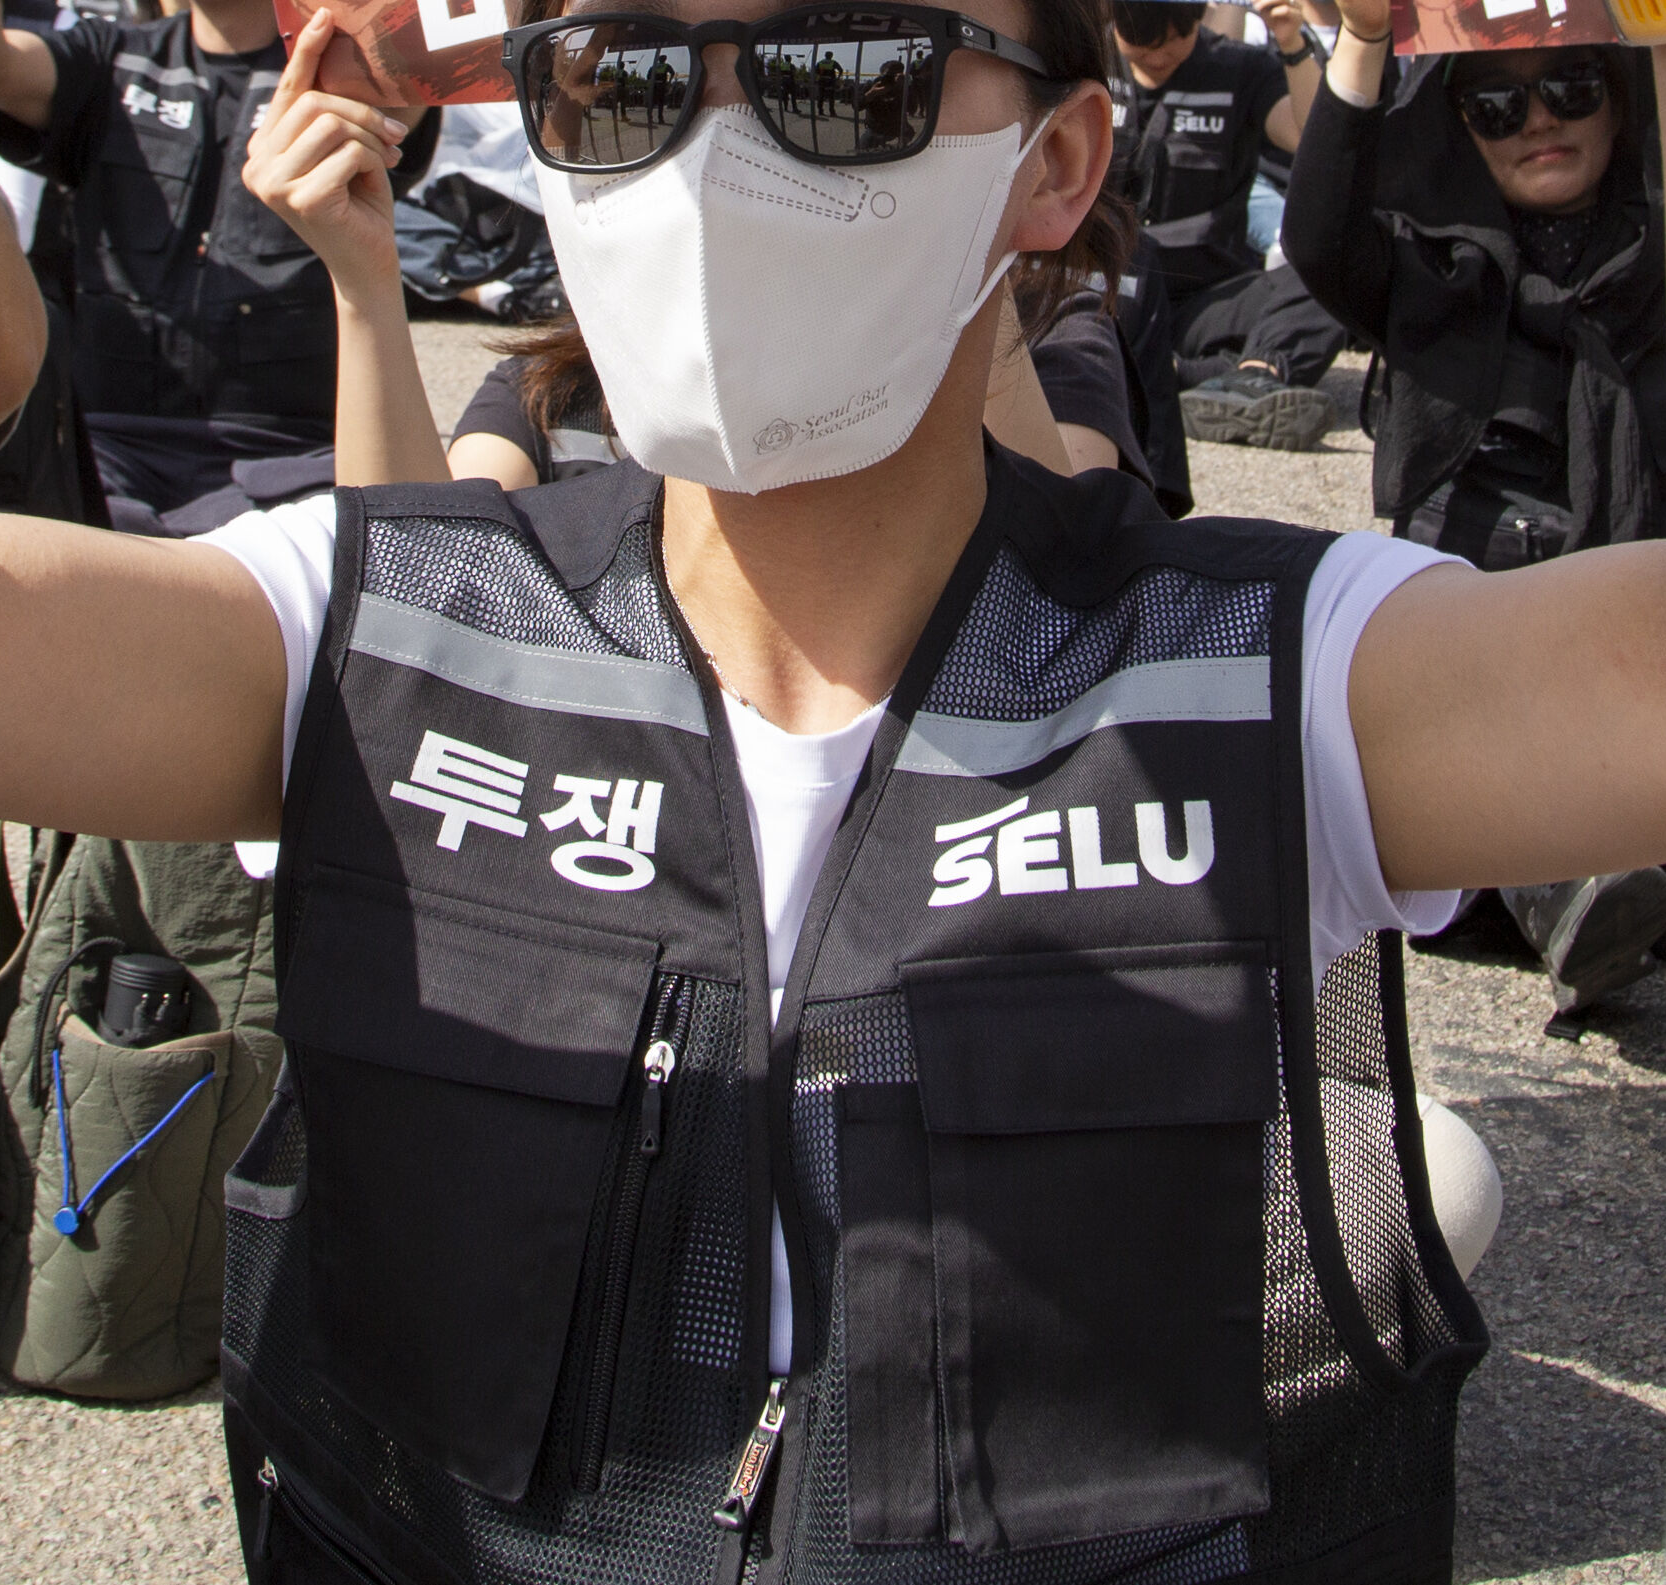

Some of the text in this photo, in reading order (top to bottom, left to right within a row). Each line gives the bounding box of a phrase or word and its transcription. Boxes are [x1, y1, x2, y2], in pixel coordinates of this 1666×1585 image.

[1174, 111, 1225, 134] SELU
[800, 383, 890, 433] Seoul Bar
[803, 399, 889, 442] Association
[389, 729, 664, 892] 투쟁
[927, 797, 1216, 907] SELU
